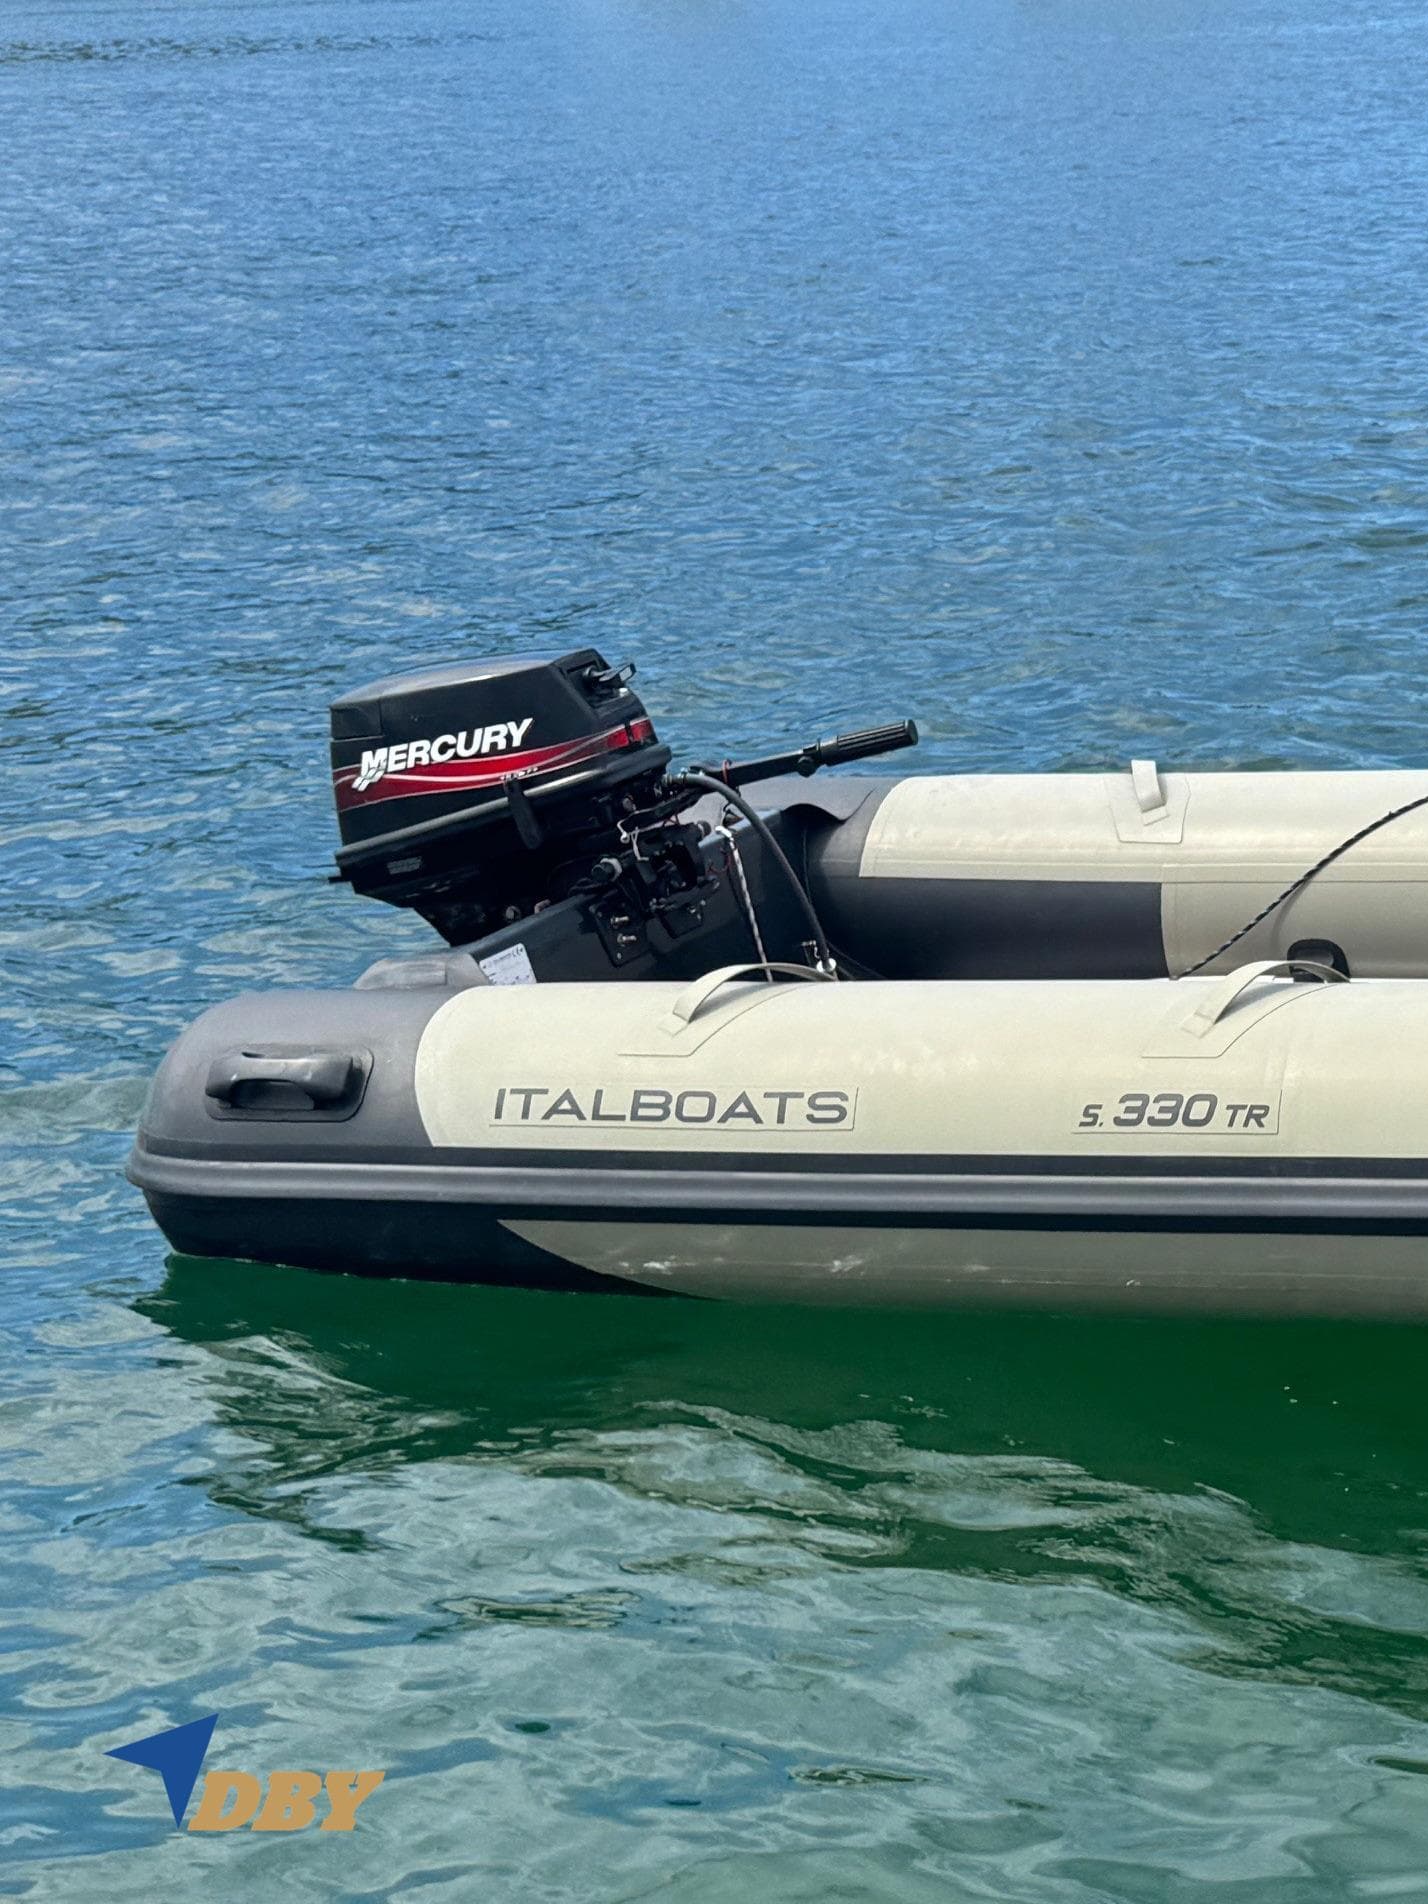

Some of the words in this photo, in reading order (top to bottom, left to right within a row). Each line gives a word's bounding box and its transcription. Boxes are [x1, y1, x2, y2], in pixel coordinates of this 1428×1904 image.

[352, 717, 533, 791] MERCURY
[493, 1088, 848, 1124] ITALBOATS
[1112, 1092, 1218, 1128] 330
[1226, 1104, 1271, 1129] TR
